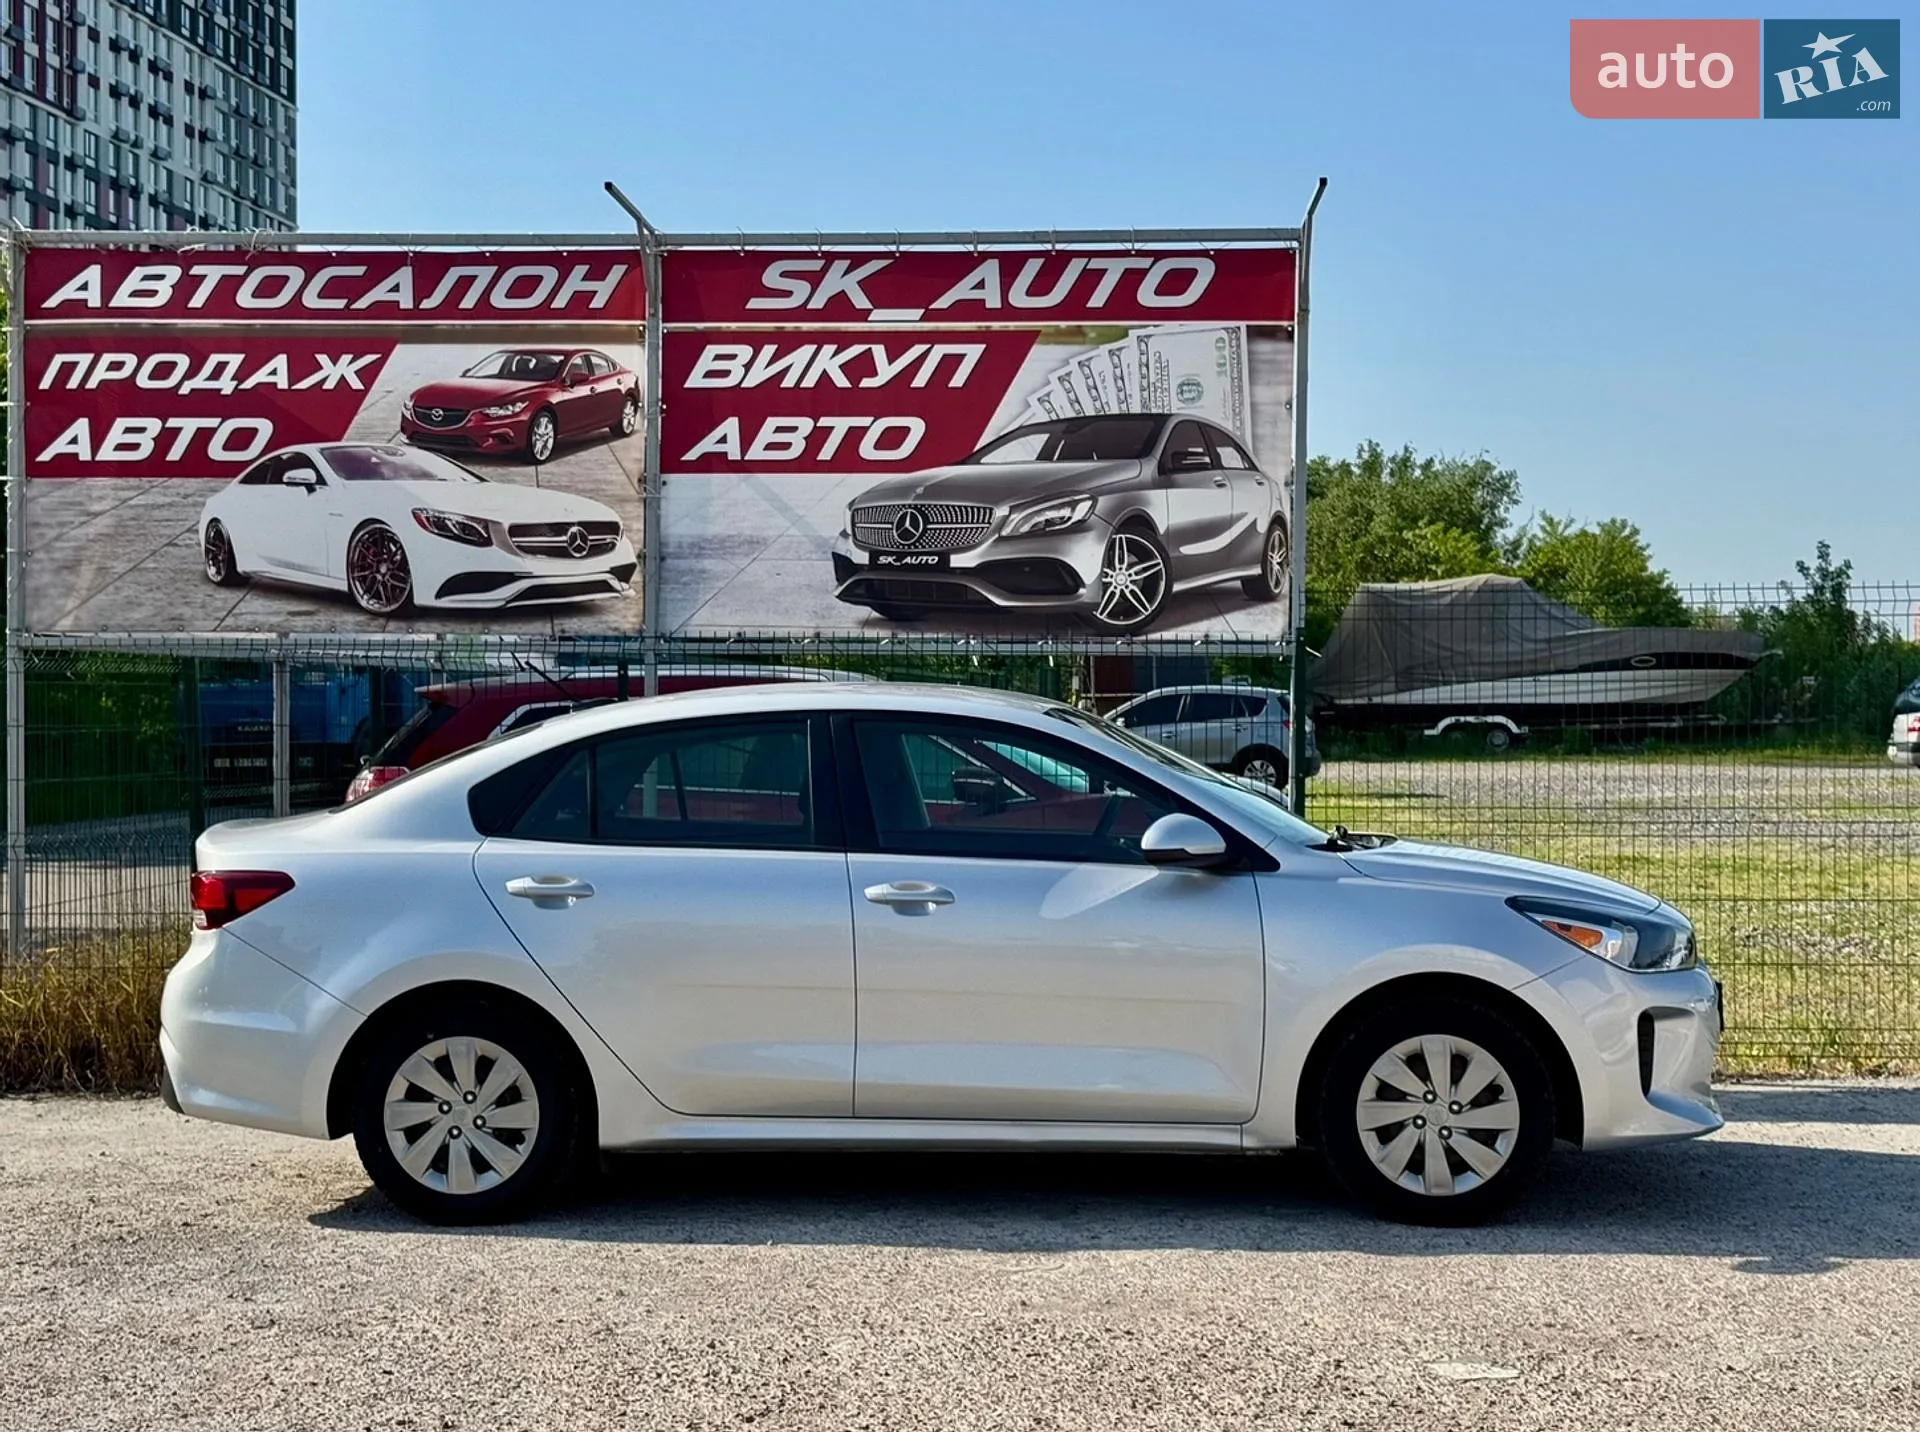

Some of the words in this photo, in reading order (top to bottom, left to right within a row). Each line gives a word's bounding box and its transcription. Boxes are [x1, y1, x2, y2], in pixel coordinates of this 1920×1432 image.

[41, 264, 629, 310] АВТОСАЛОН
[745, 257, 1216, 321] SK_AUTO
[38, 352, 382, 396] ПРОДАЖ
[683, 343, 986, 389] ВИКУП
[35, 417, 274, 462] АВТО
[680, 416, 926, 461] АВТО
